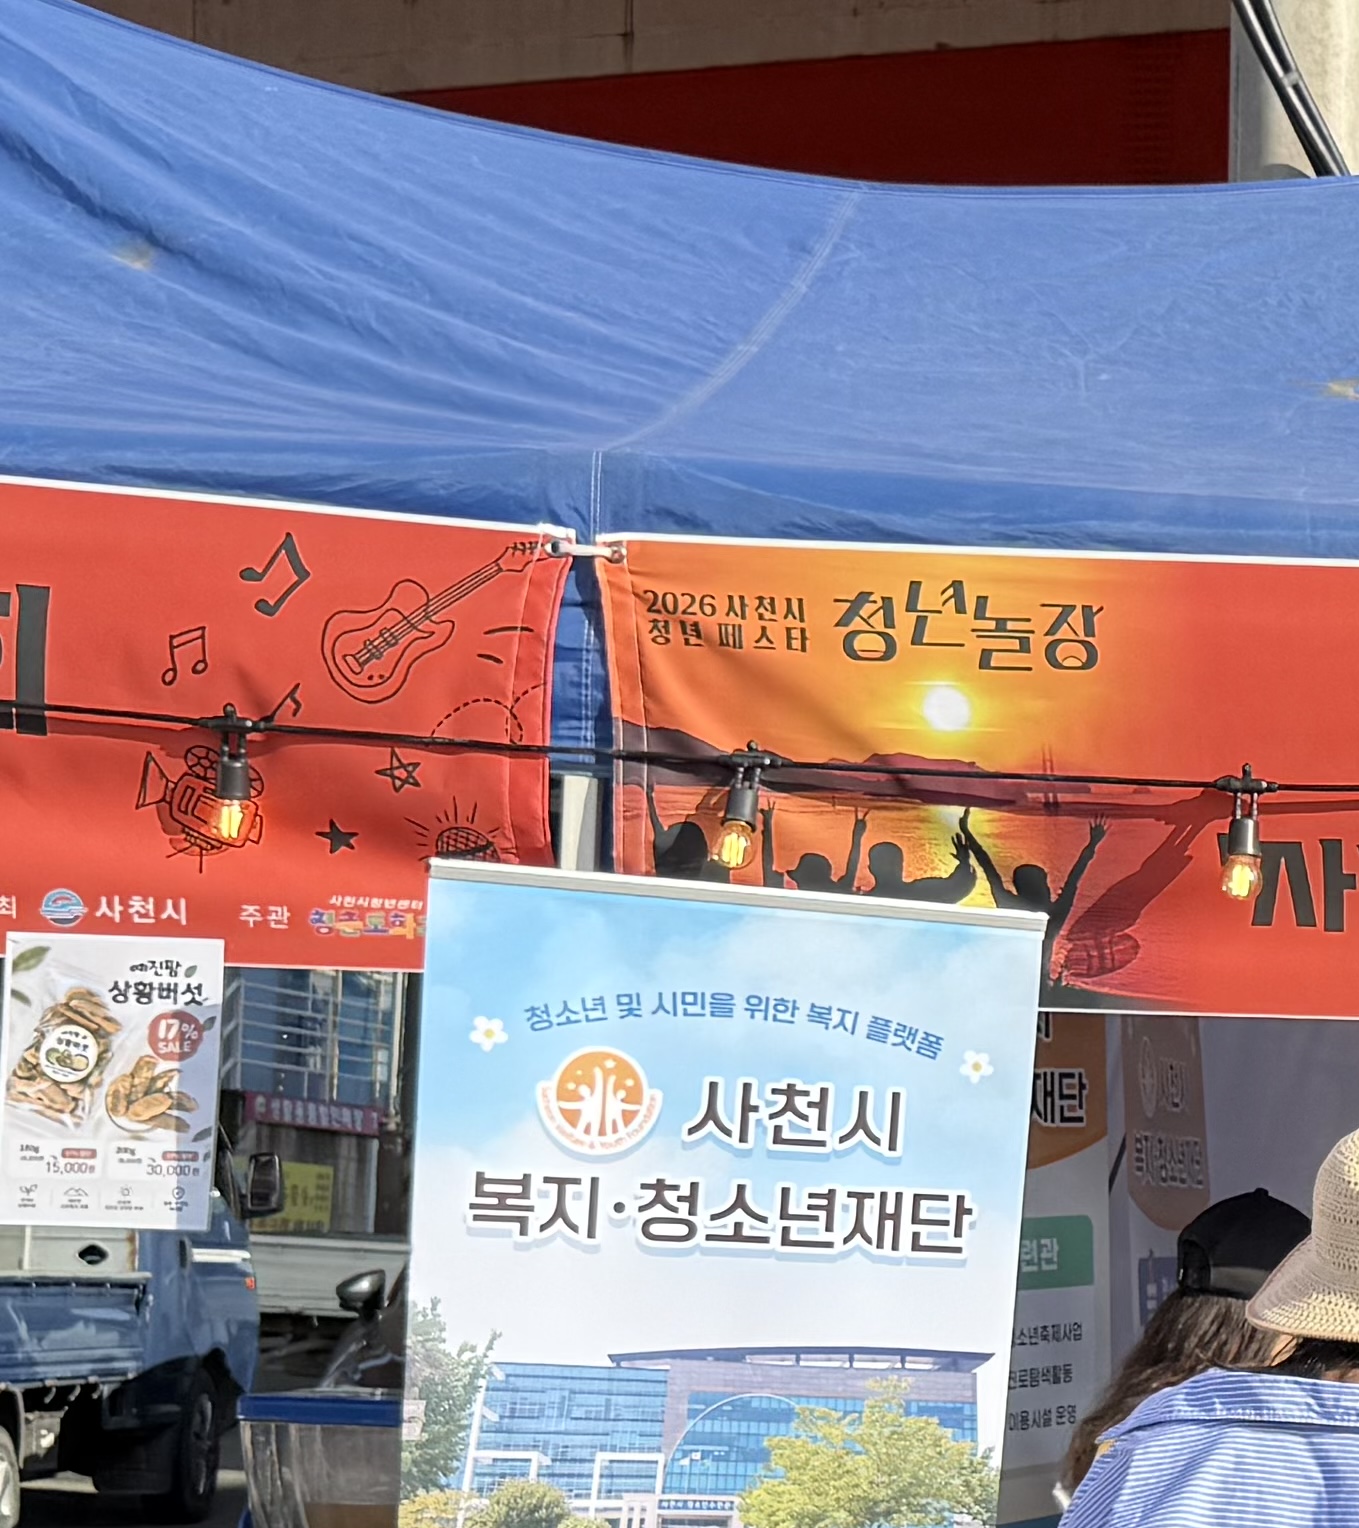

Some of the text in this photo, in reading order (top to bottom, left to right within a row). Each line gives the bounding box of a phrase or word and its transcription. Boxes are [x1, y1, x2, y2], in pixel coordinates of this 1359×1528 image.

[643, 589, 806, 624] 2026 사천시
[648, 618, 811, 654] 청년 페스타
[833, 579, 1105, 673] 청년놀장
[95, 895, 187, 926] 사천시
[240, 903, 290, 930] 주관
[107, 980, 205, 1006] 상황버섯
[158, 1018, 198, 1040] 17%
[525, 990, 946, 1060] 청소년 및 시민을 위한 복지 플랫폼
[157, 1040, 192, 1053] SALE
[685, 1079, 904, 1154] 사천시
[467, 1169, 974, 1255] 복지·청소년재단
[1011, 1322, 1083, 1348] 소년축제사업
